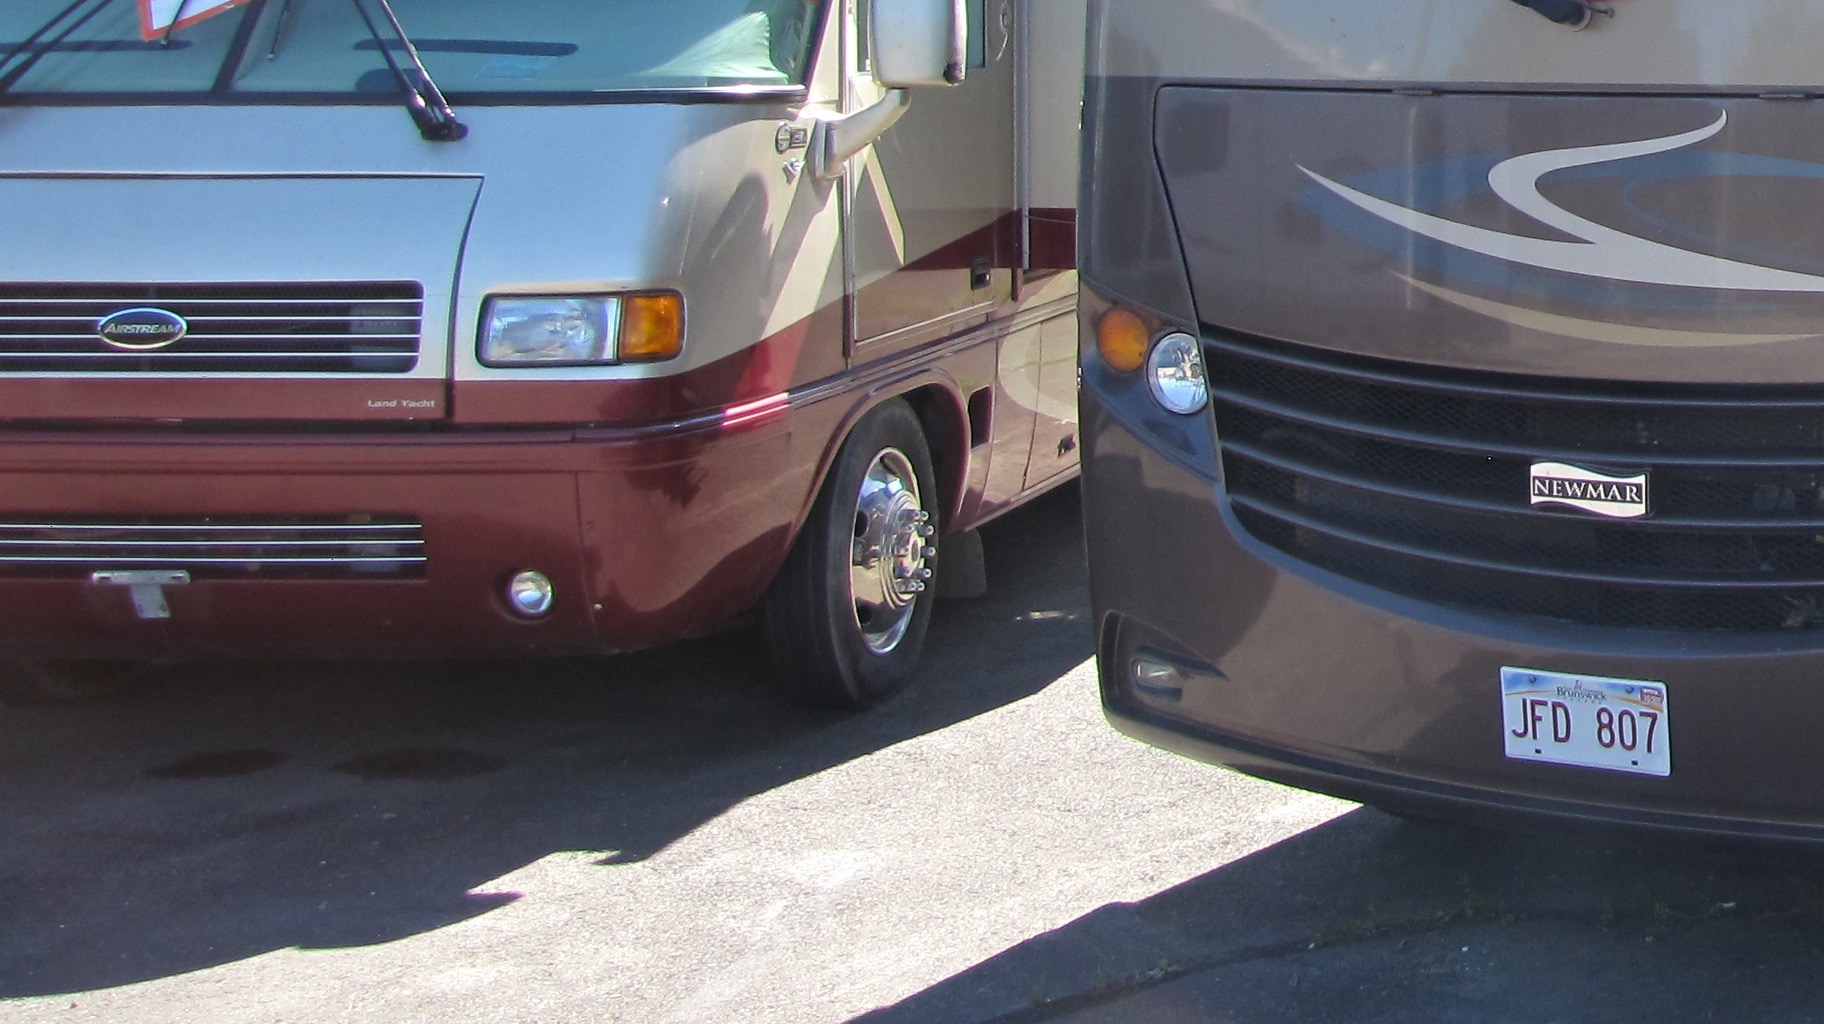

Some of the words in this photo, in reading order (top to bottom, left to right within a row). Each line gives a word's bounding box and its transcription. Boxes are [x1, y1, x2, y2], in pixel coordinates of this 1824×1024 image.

[104, 322, 180, 334] AIRSTREAM
[367, 399, 397, 408] Land
[402, 399, 435, 408] Yacht
[1534, 478, 1641, 502] NEWMAR
[1511, 697, 1572, 743] JFD
[1596, 706, 1659, 754] 807
